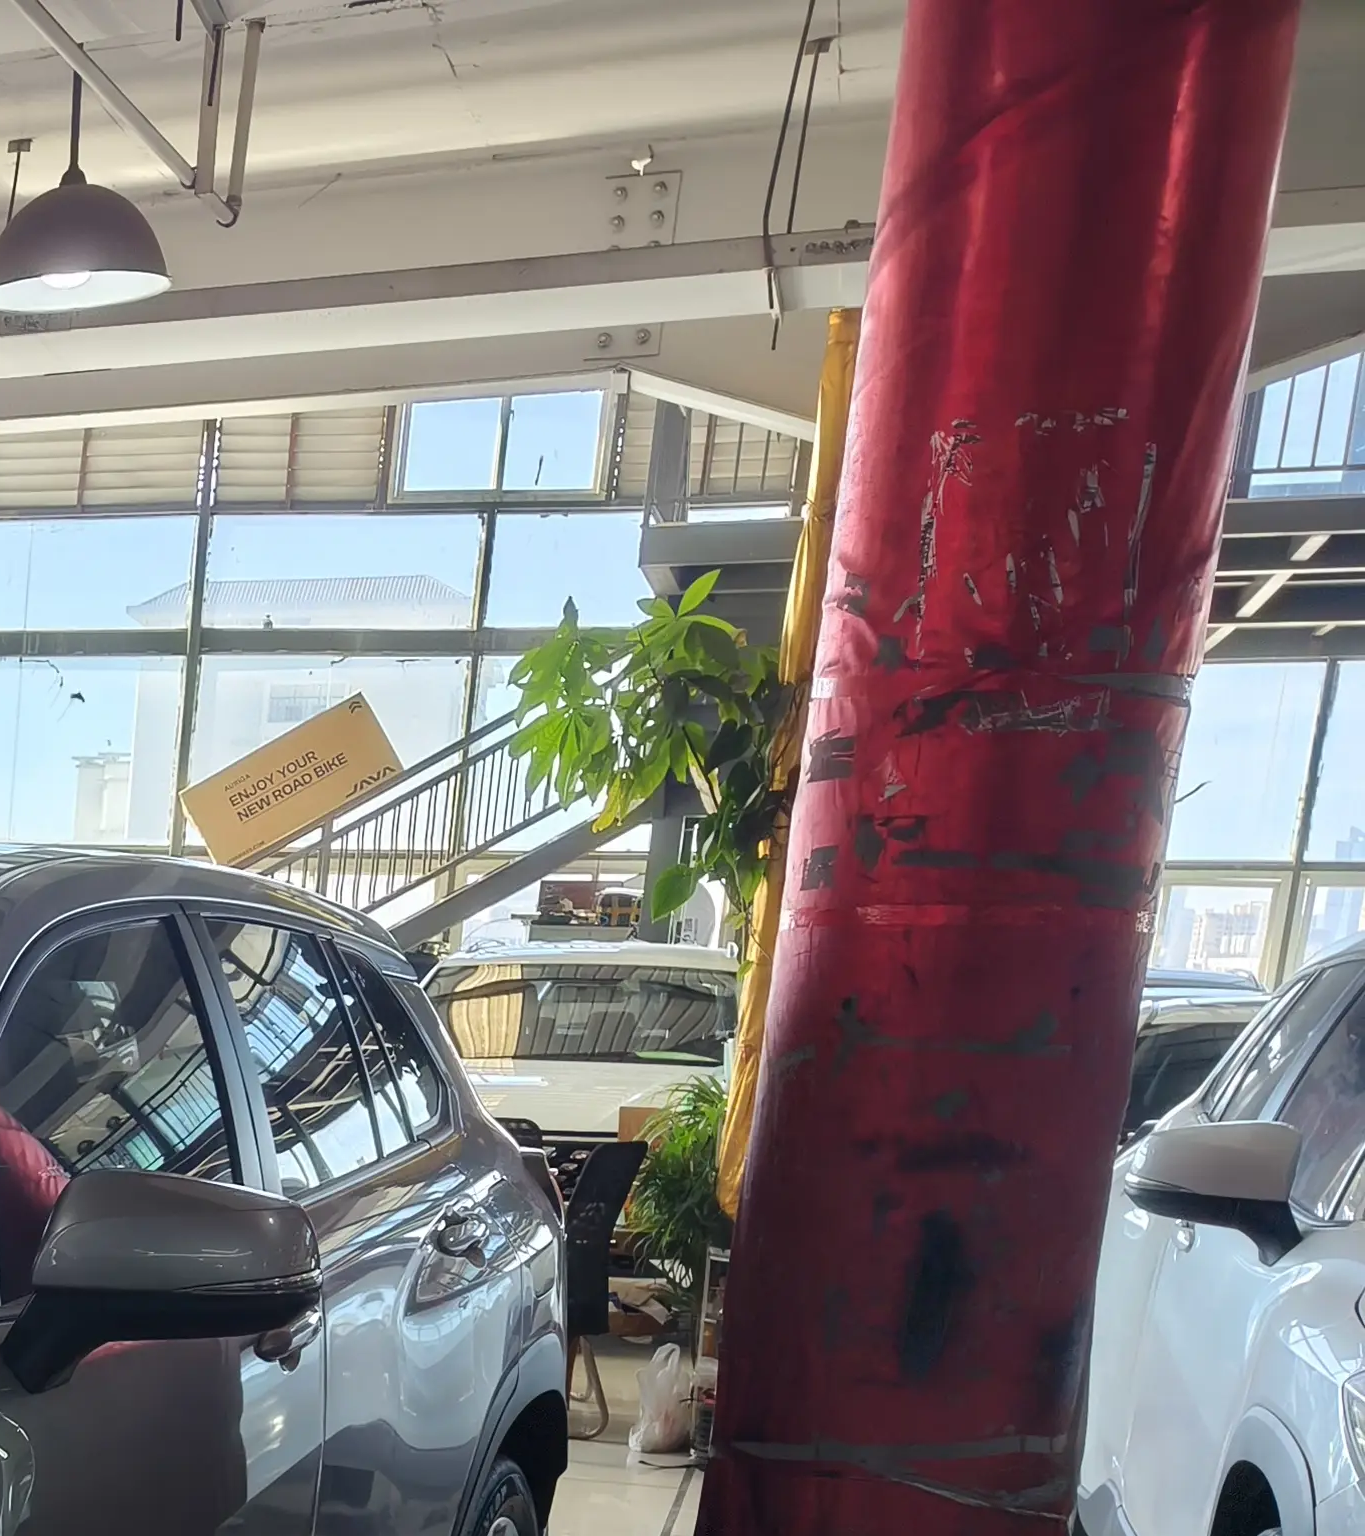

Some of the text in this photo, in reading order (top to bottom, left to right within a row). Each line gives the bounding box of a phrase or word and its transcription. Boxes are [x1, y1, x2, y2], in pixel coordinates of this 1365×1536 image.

[229, 751, 318, 807] ENJOY YOUR
[237, 752, 348, 821] NEW ROAD BIKE
[346, 766, 396, 798] JAVA
